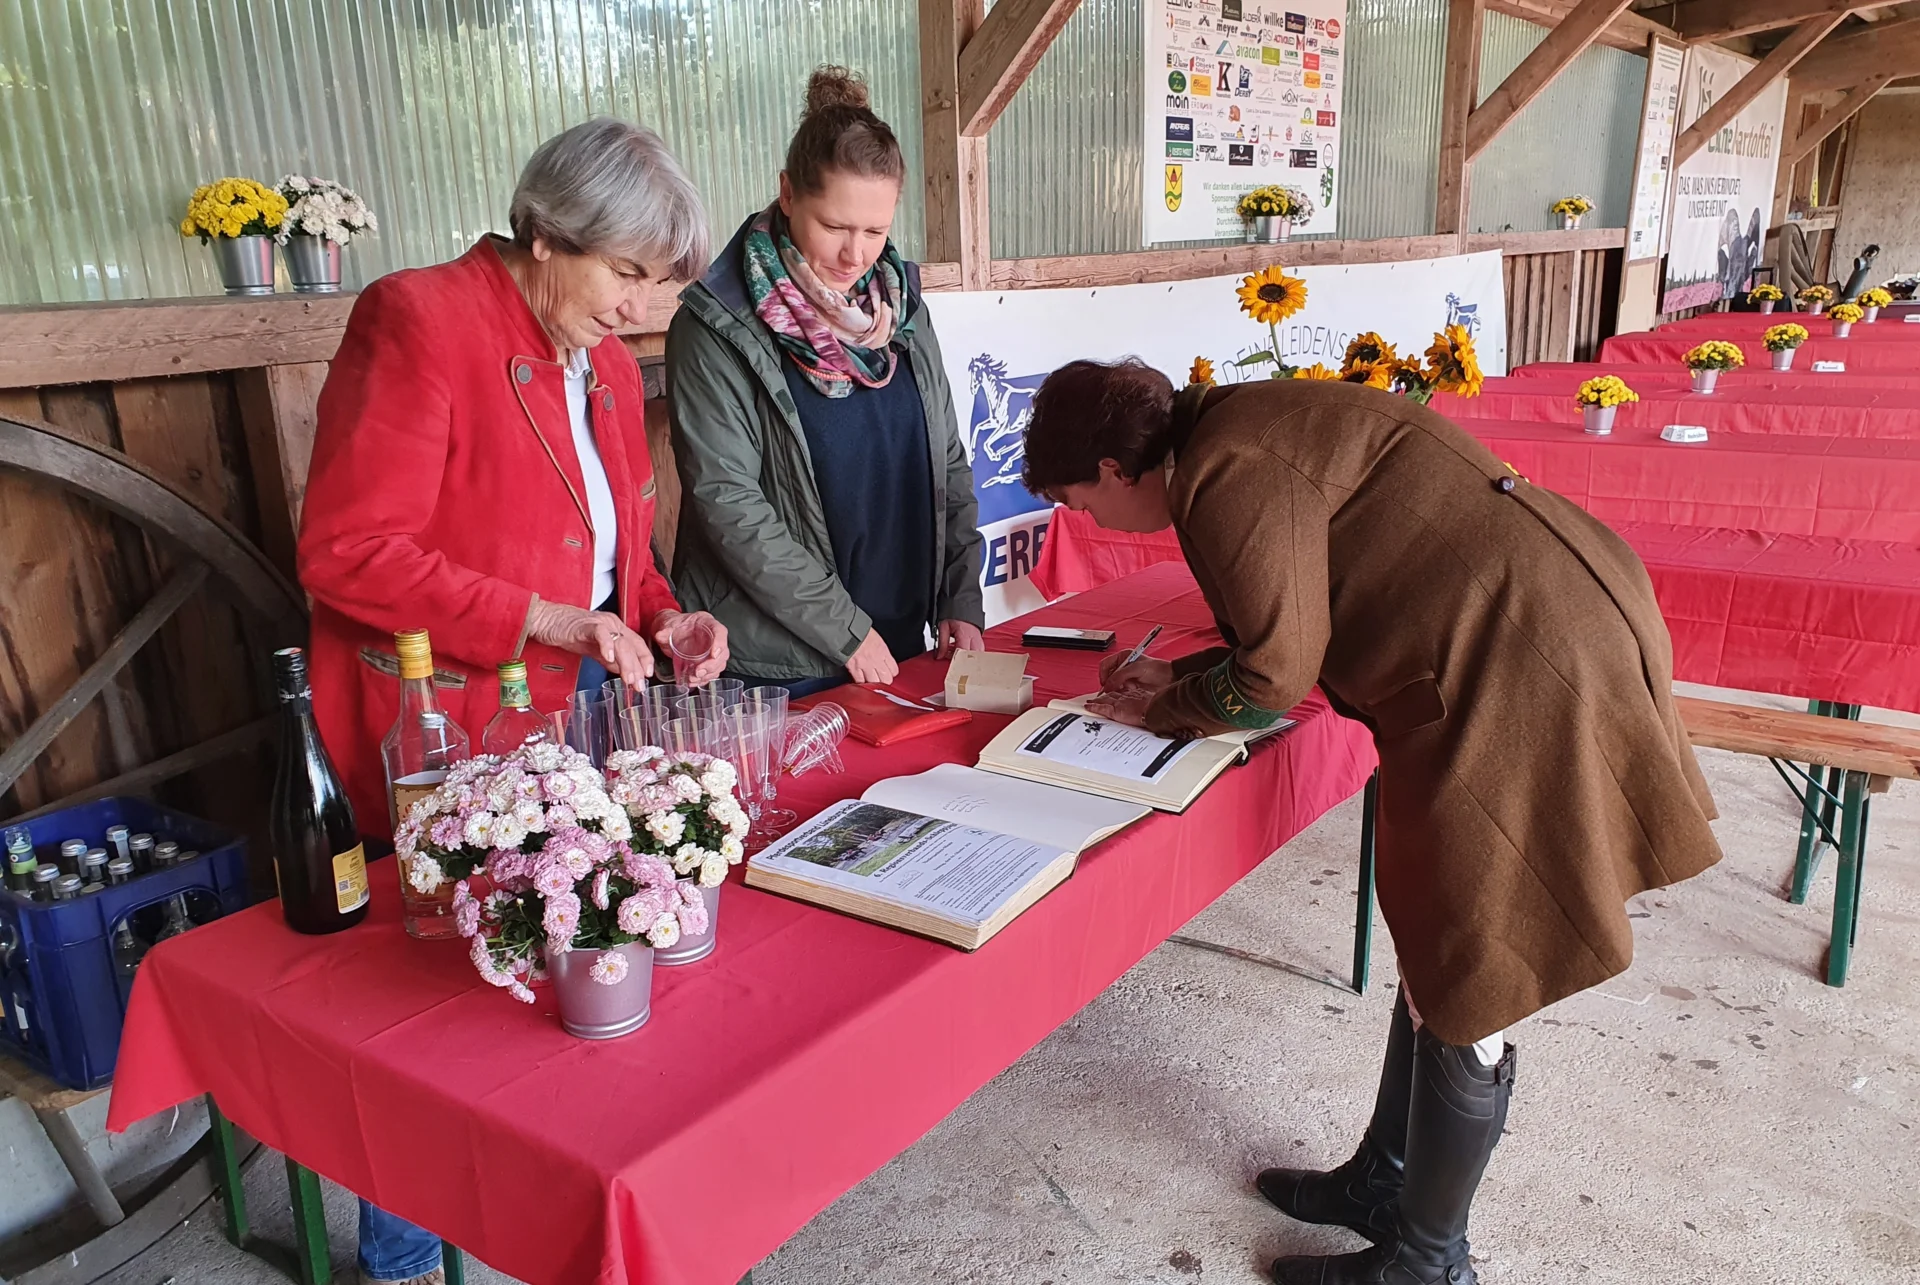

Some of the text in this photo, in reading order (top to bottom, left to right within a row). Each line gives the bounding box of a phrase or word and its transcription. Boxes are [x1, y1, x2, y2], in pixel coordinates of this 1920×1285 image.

[1263, 11, 1284, 28] willke
[1216, 22, 1239, 38] meyer
[1236, 45, 1261, 60] avacon
[1195, 62, 1215, 70] Objekt
[1234, 87, 1254, 98] DERBY
[1166, 94, 1190, 110] moin
[1203, 182, 1211, 191] Wir
[1212, 182, 1230, 191] danken
[1231, 182, 1242, 191] allen
[1281, 324, 1355, 360] LEIDENS
